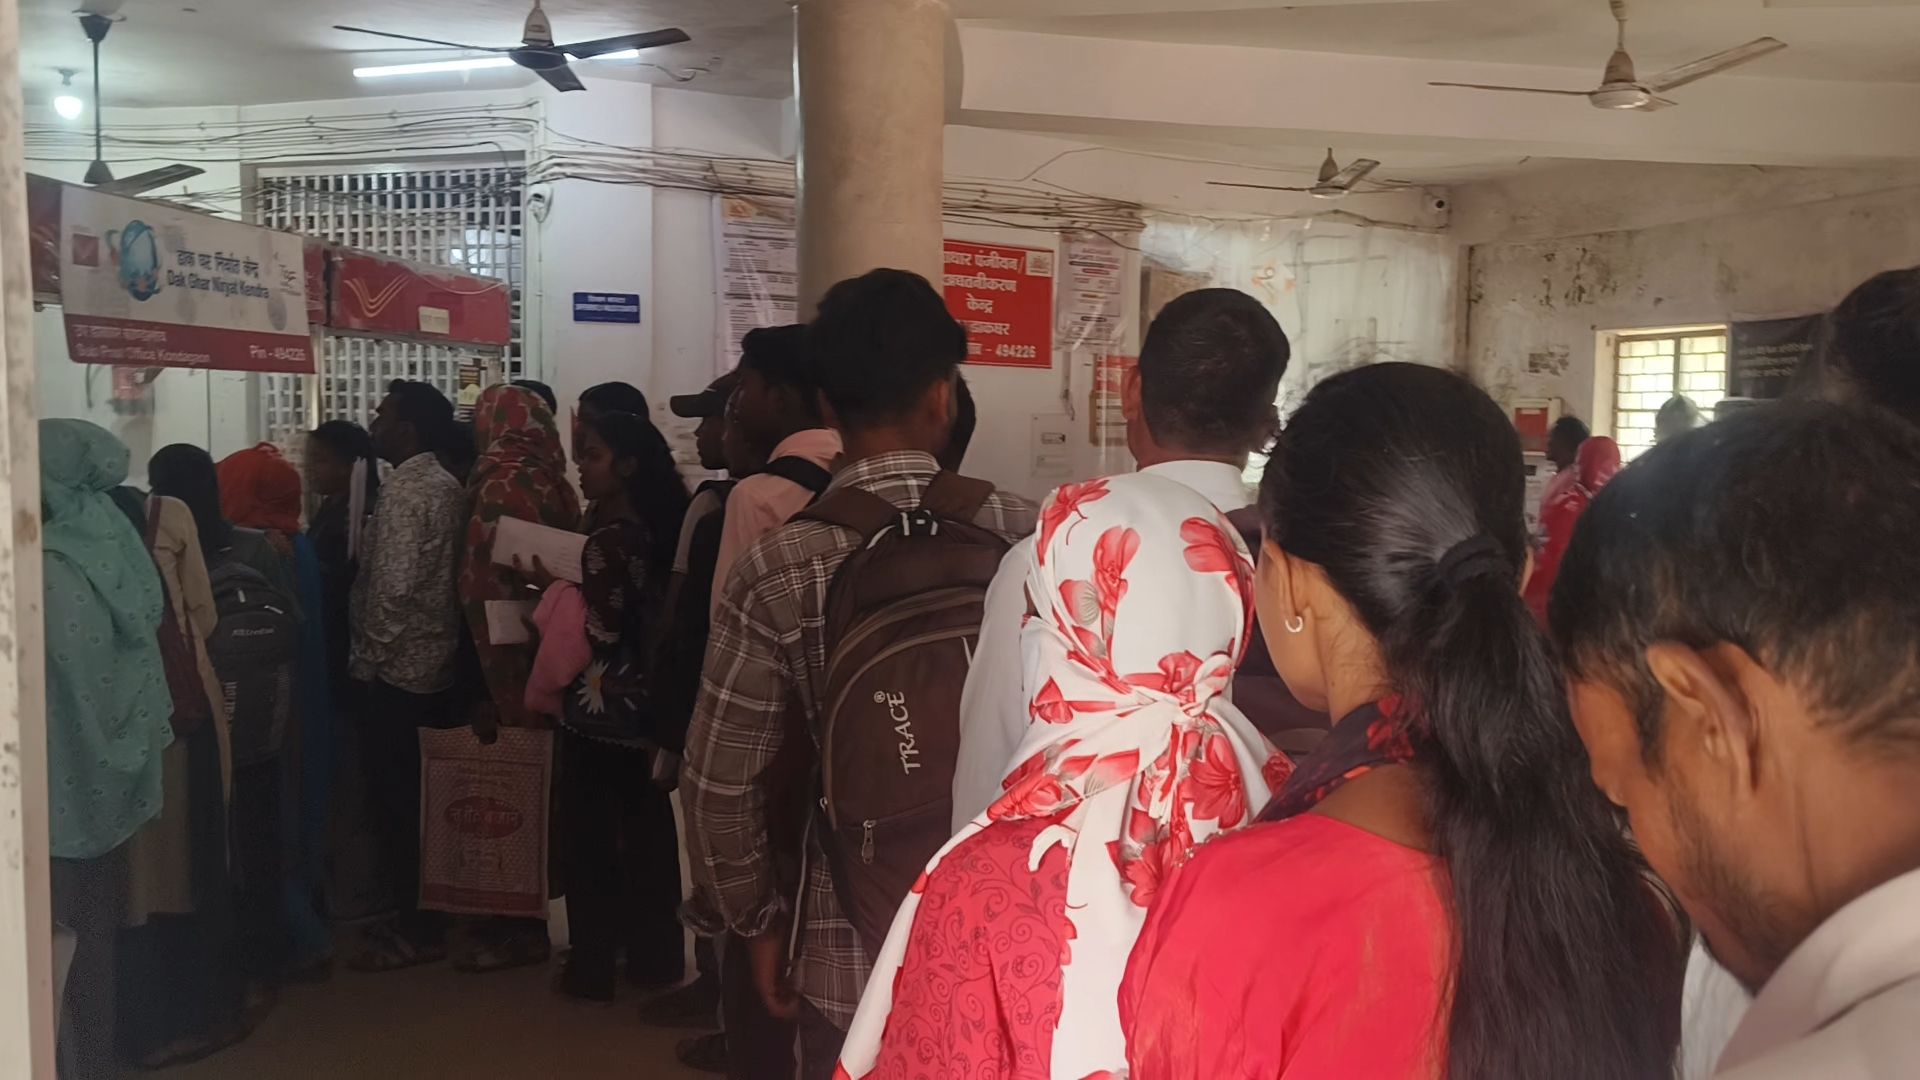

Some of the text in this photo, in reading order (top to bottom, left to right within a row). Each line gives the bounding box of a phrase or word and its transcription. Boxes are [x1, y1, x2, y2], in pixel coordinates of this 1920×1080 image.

[943, 250, 973, 266] धार
[167, 269, 185, 287] Dak
[239, 281, 269, 299] Kendra
[249, 344, 267, 359] Pin
[995, 343, 1037, 359] 494226
